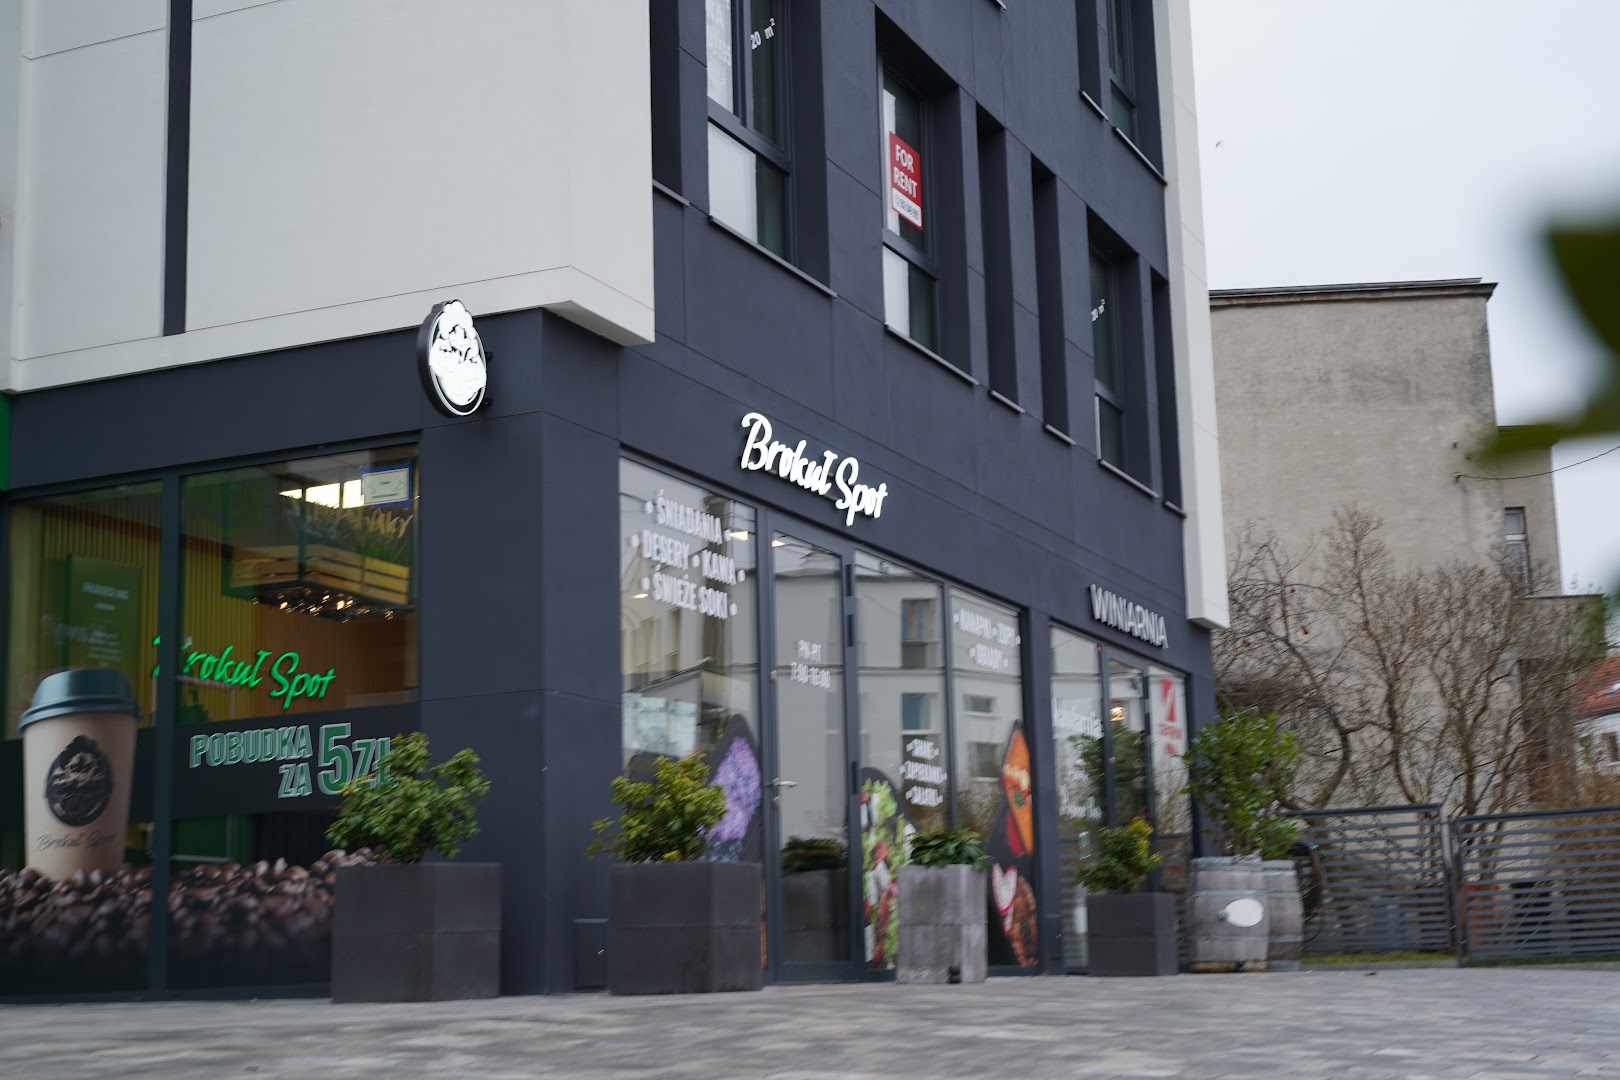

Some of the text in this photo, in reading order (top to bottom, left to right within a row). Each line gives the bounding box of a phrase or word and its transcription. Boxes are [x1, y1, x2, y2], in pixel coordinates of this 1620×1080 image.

[750, 31, 762, 50] 20
[893, 166, 918, 198] RENT
[894, 144, 915, 174] FOR
[656, 489, 723, 545] ŚNIADANIA
[835, 457, 888, 527] Spot
[642, 529, 737, 586] DESERY KAWA
[652, 563, 728, 620] ŚWIEŻE SOKI
[1090, 583, 1169, 650] WINIARNIA
[269, 652, 336, 710] Spot
[189, 724, 313, 768] POBUDKA
[278, 762, 312, 799] ZA
